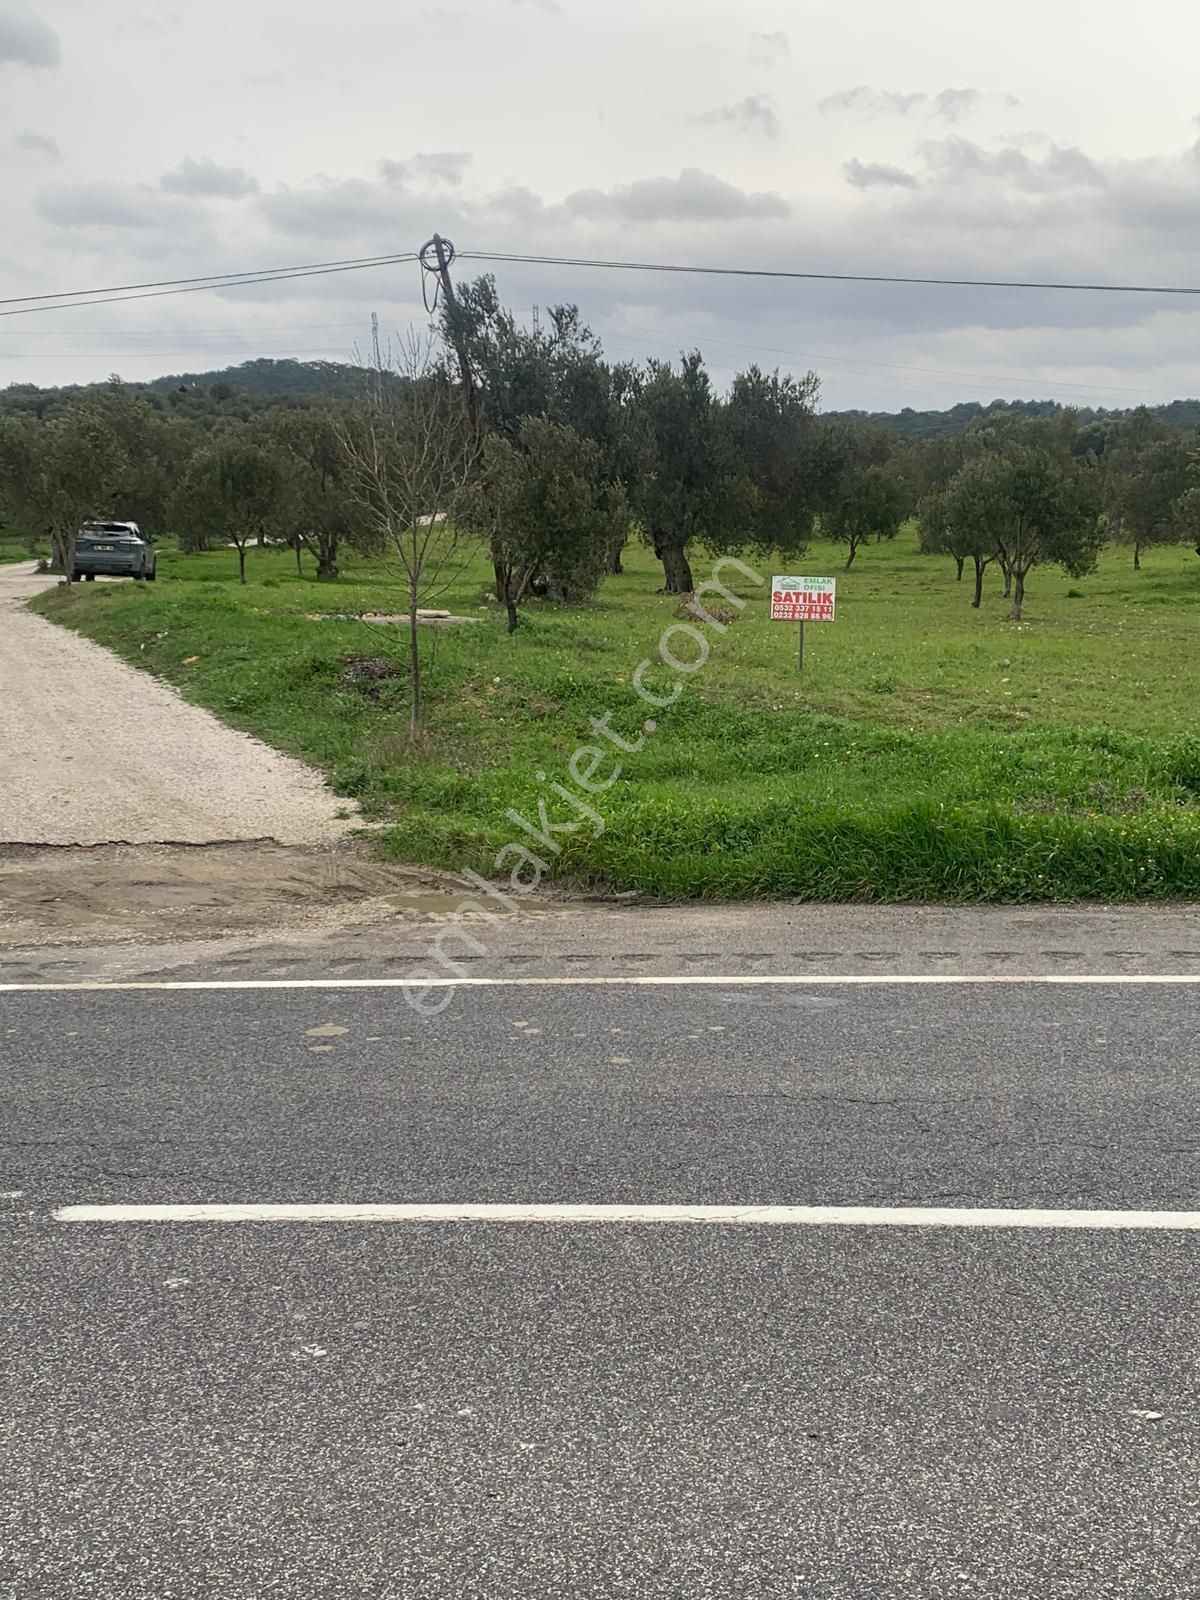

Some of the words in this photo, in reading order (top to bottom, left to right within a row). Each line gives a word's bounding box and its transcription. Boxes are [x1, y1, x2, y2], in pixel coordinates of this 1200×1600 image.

[773, 592, 833, 604] SATILIK
[774, 604, 793, 612] 0532
[794, 611, 809, 619] 628
